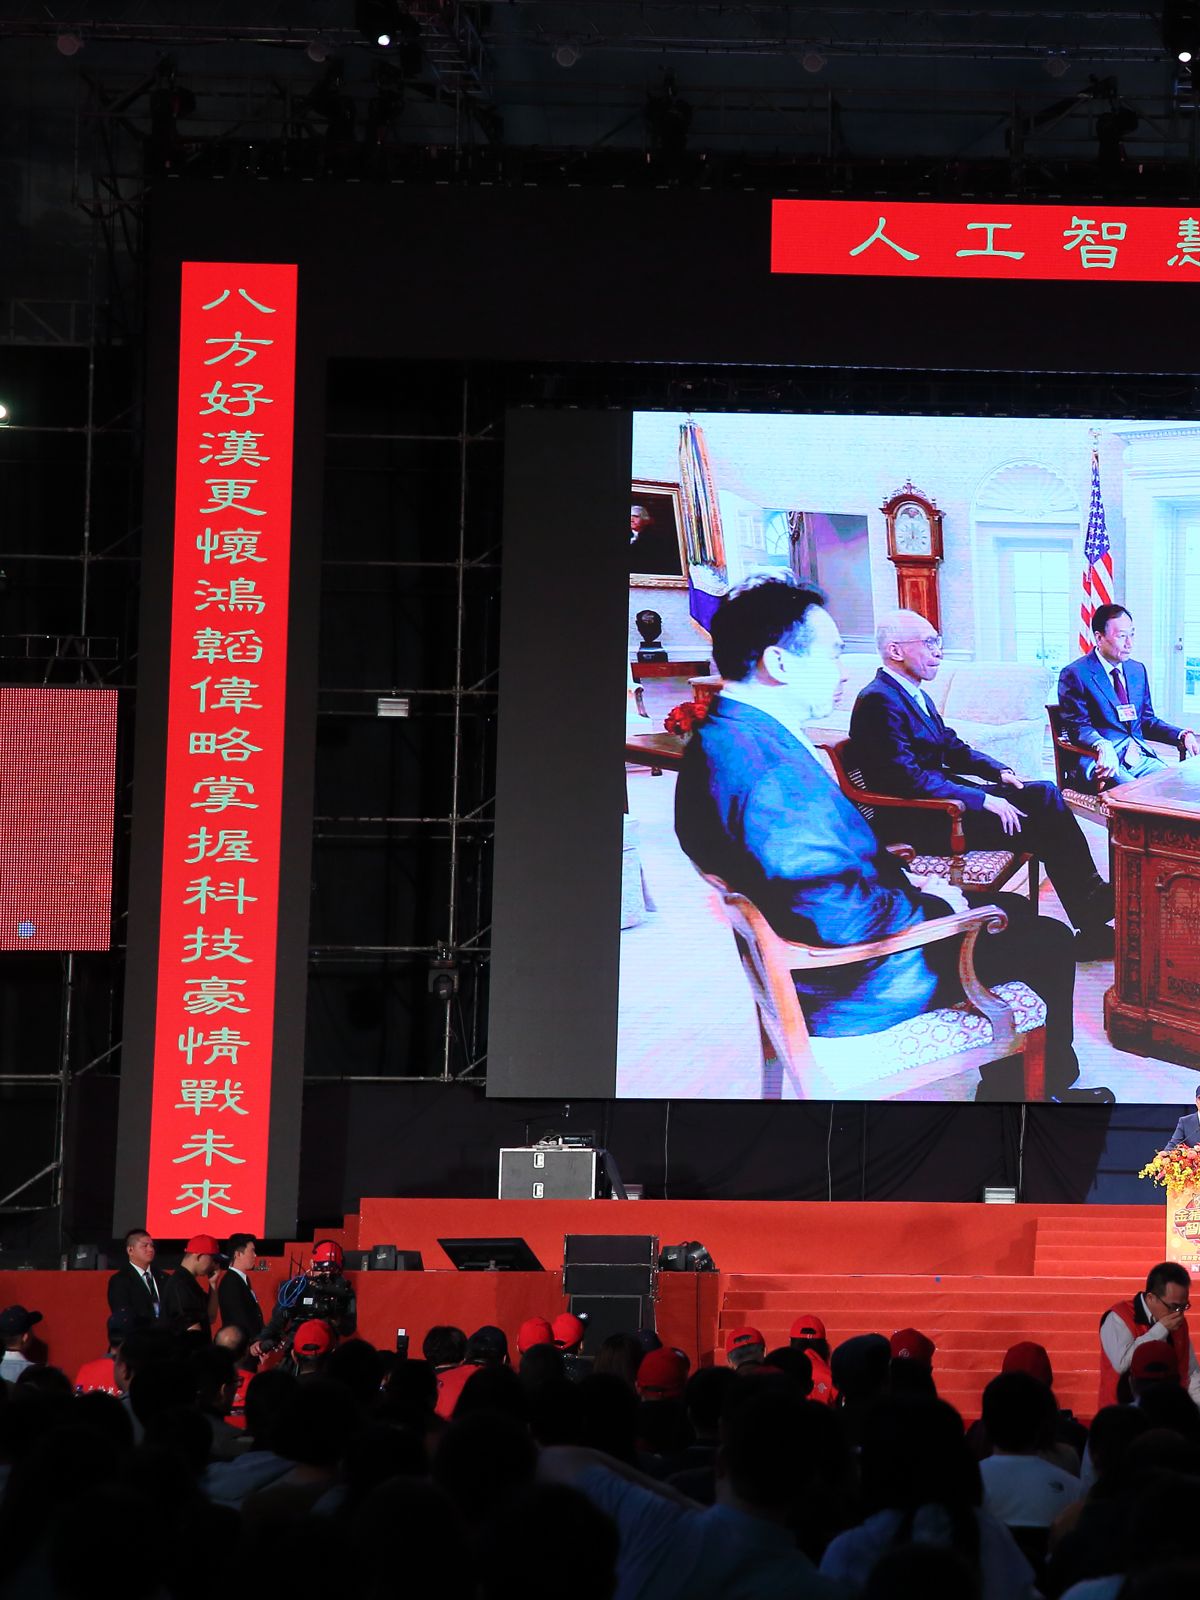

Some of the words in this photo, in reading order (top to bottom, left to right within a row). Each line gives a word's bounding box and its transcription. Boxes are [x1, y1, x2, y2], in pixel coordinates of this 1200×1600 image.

[170, 288, 277, 1218] 八方好漢更懷鴻韜偉略掌握科技豪情戰未來
